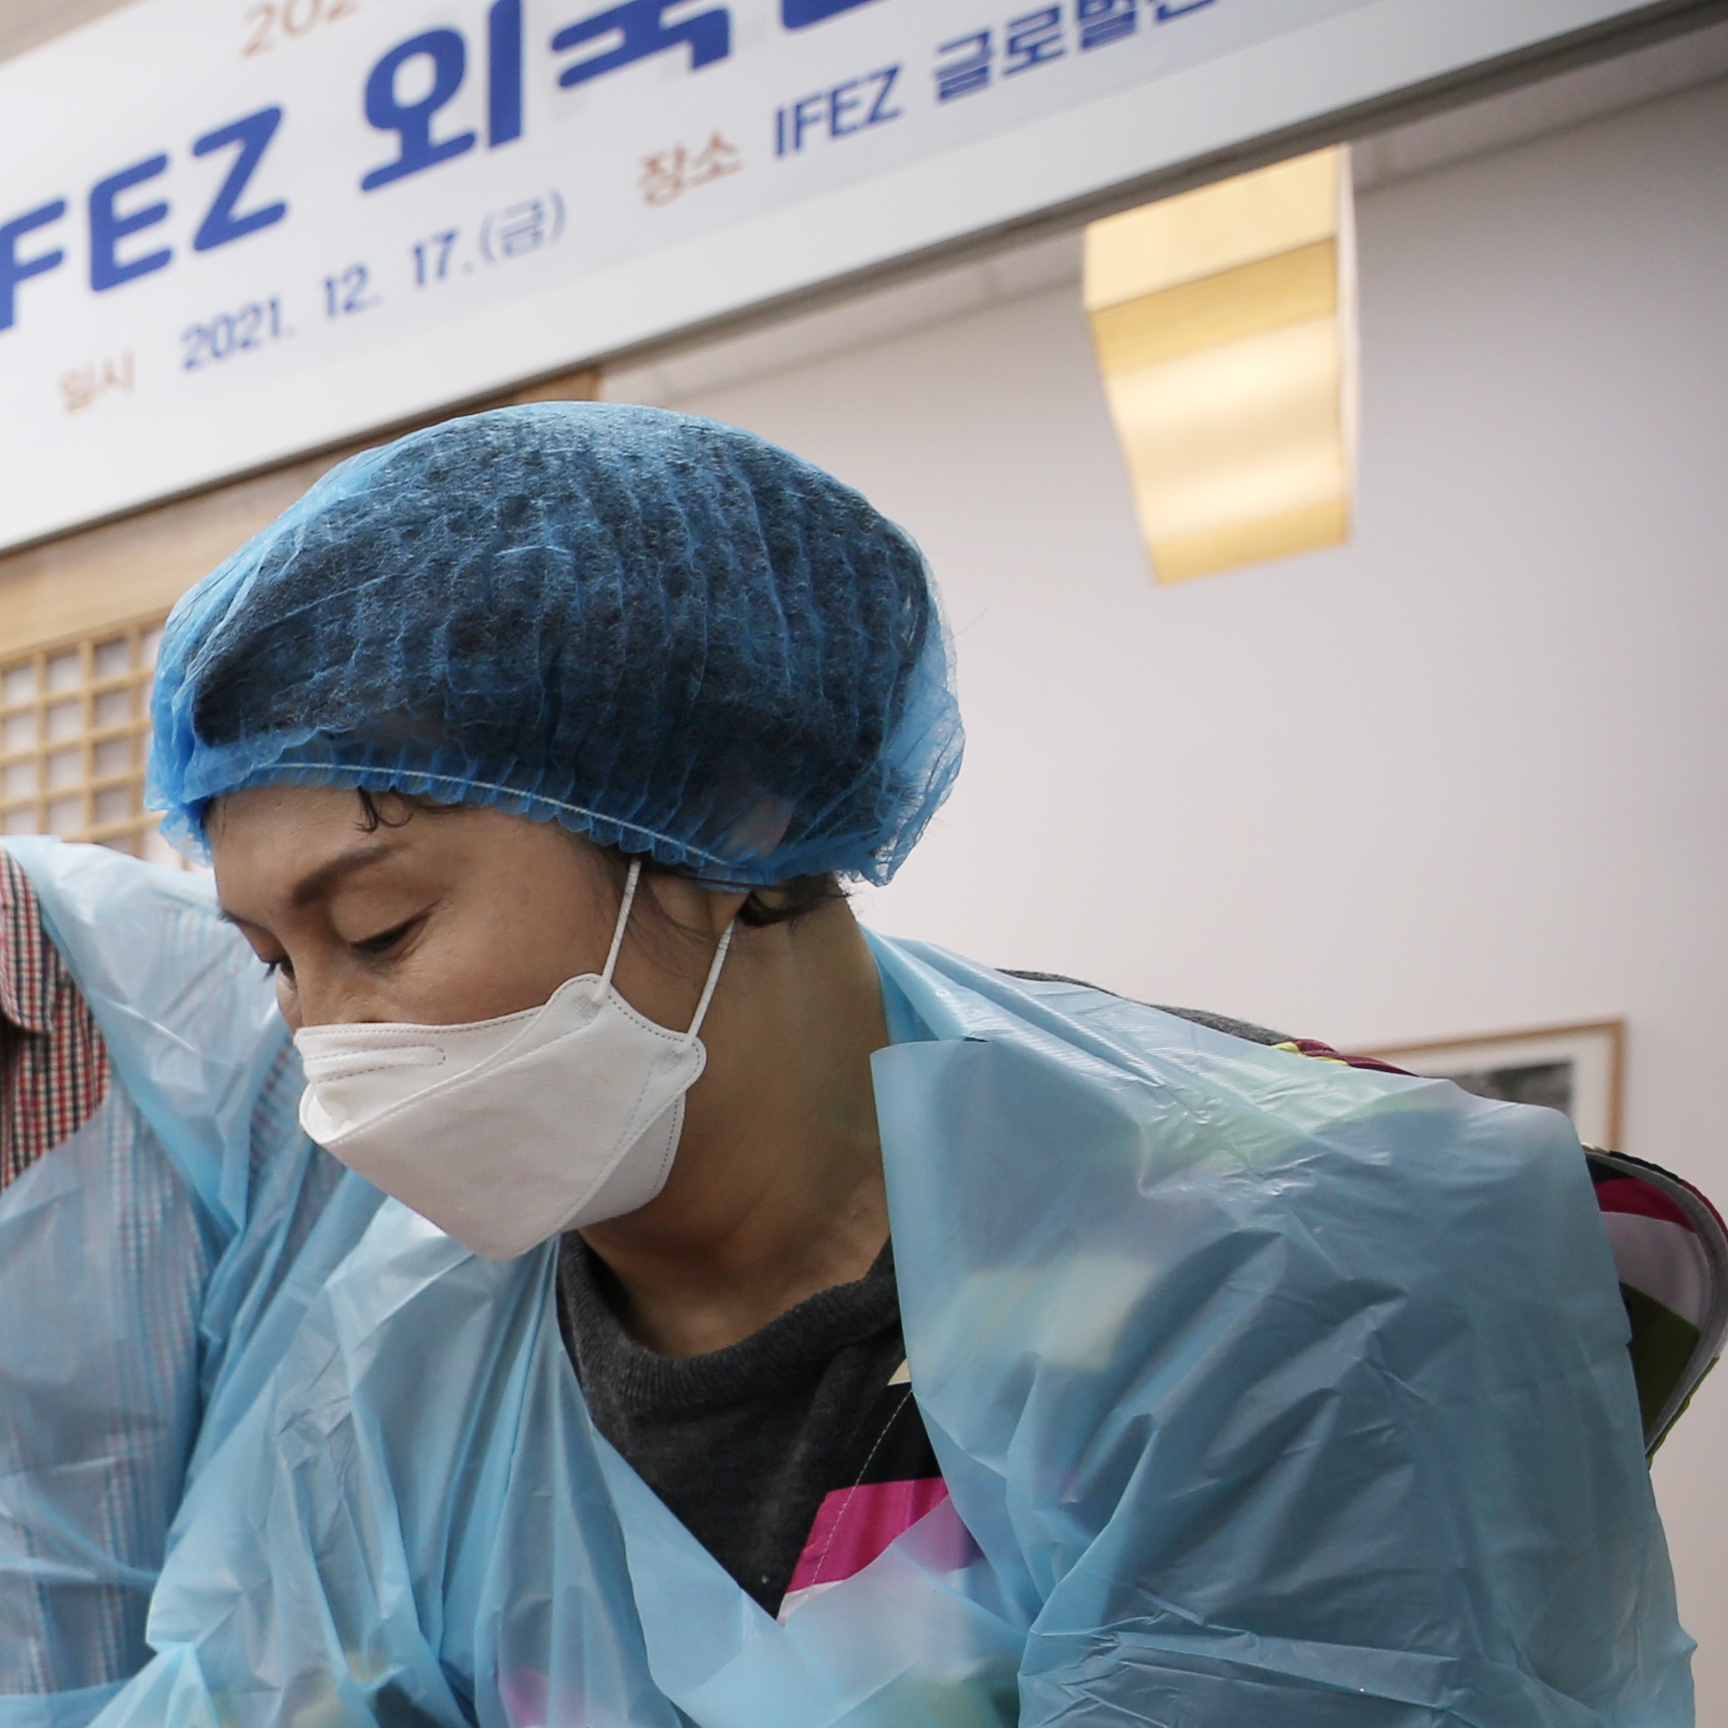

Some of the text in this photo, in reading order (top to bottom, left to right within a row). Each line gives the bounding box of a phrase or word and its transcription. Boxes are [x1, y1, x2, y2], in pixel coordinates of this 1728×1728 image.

[360, 0, 884, 191] 외국
[636, 132, 744, 207] 장소
[774, 64, 902, 158] IFEZ
[58, 350, 135, 415] 일시
[182, 298, 295, 371] 2021.
[325, 262, 382, 319] 12.
